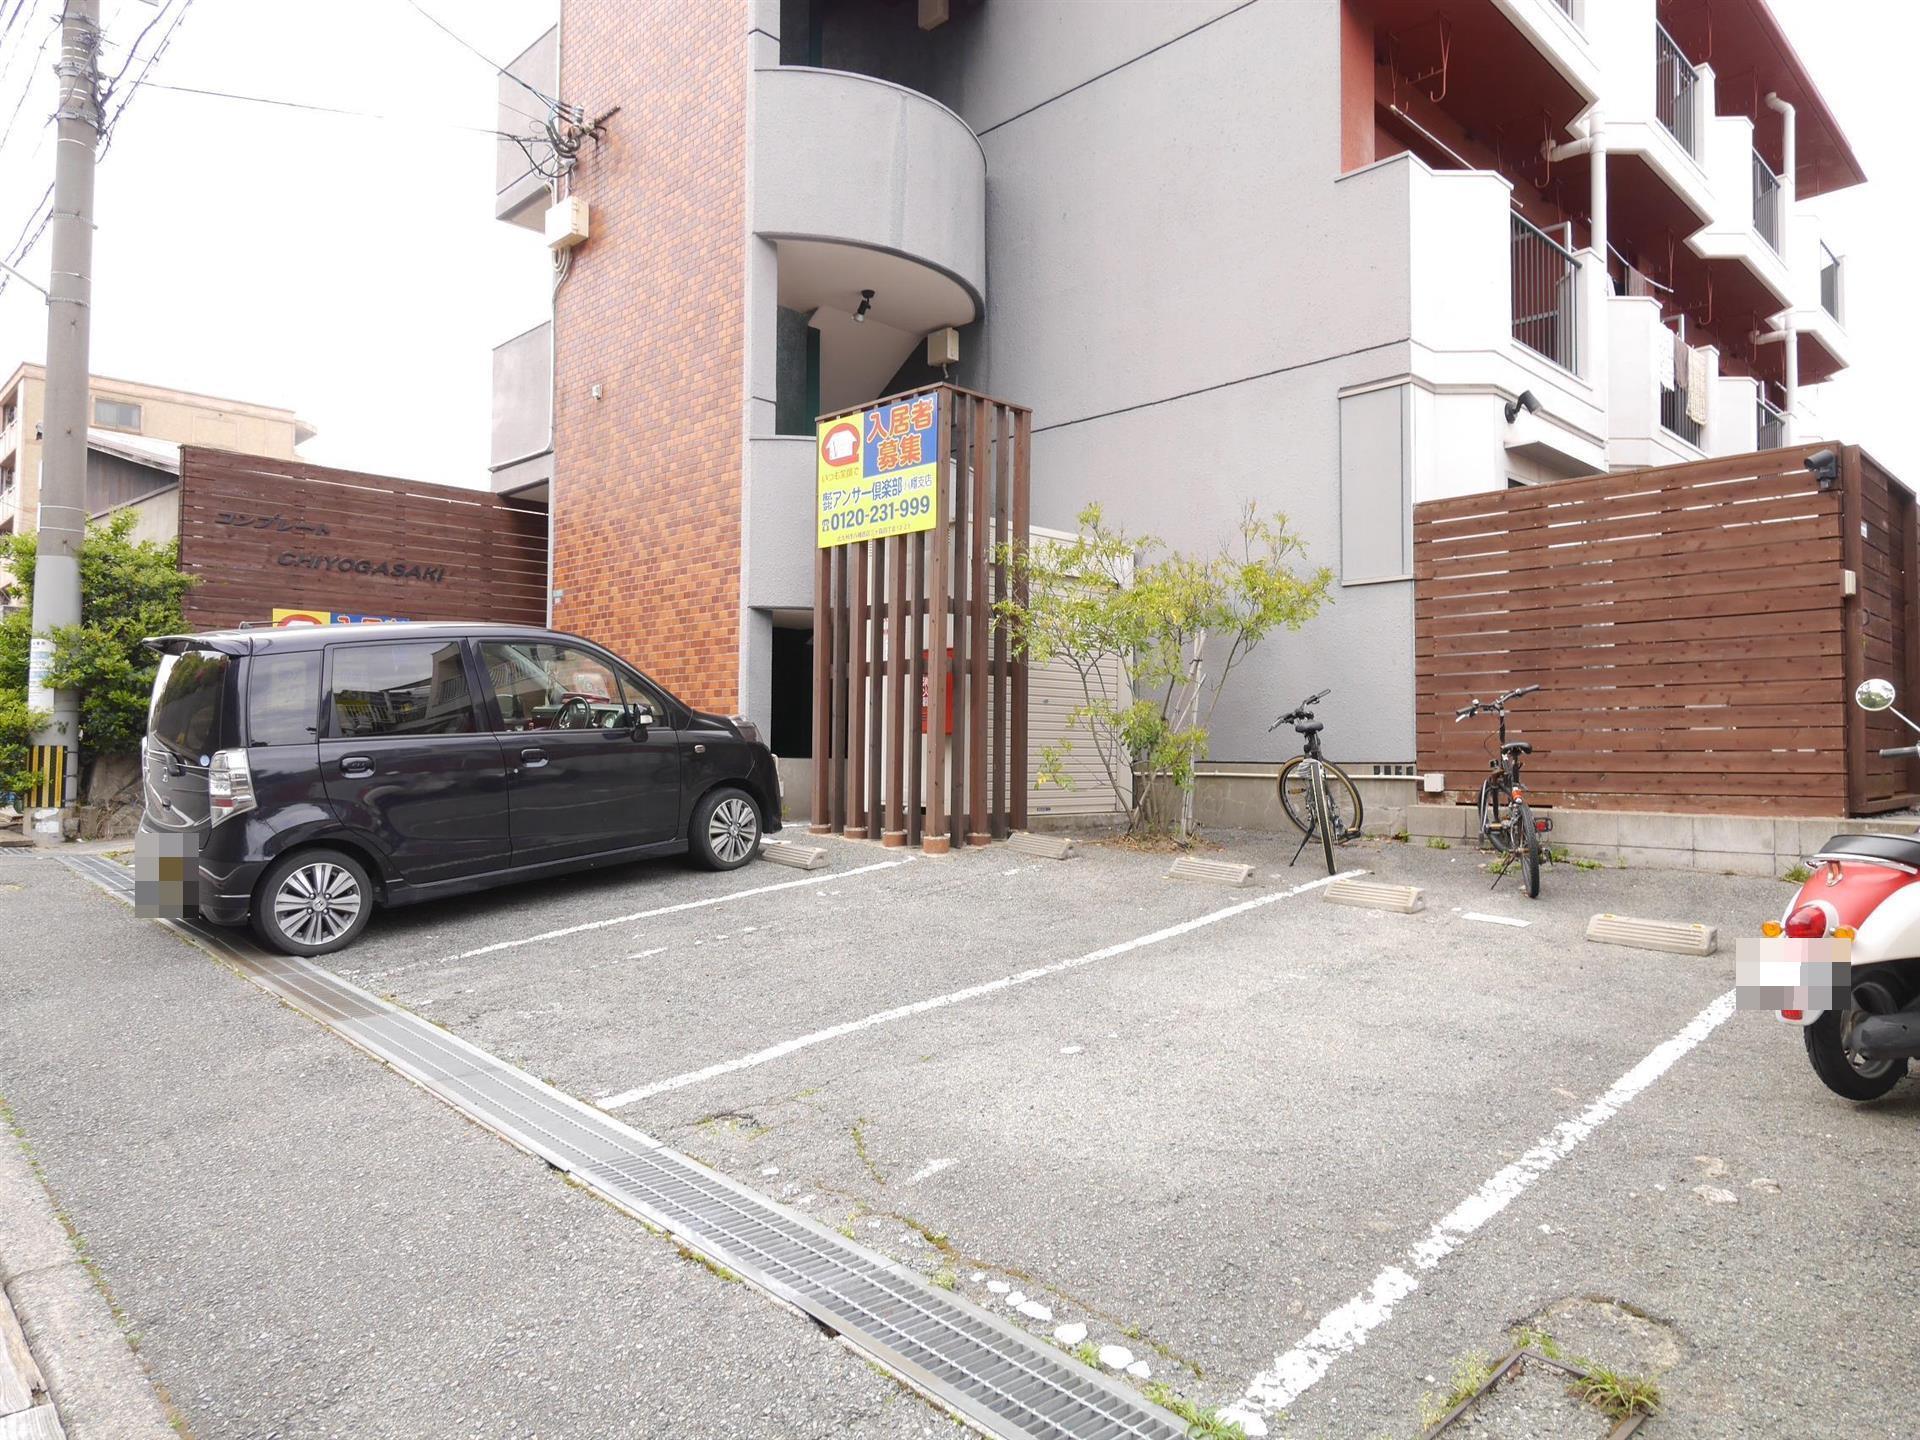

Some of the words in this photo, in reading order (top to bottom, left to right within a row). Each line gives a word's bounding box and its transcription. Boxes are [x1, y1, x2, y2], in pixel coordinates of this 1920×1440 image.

[867, 399, 934, 444] 入居者
[877, 433, 922, 472] 募集
[831, 495, 930, 531] 0120-231-999
[277, 551, 447, 583] CHIYOGASAKI
